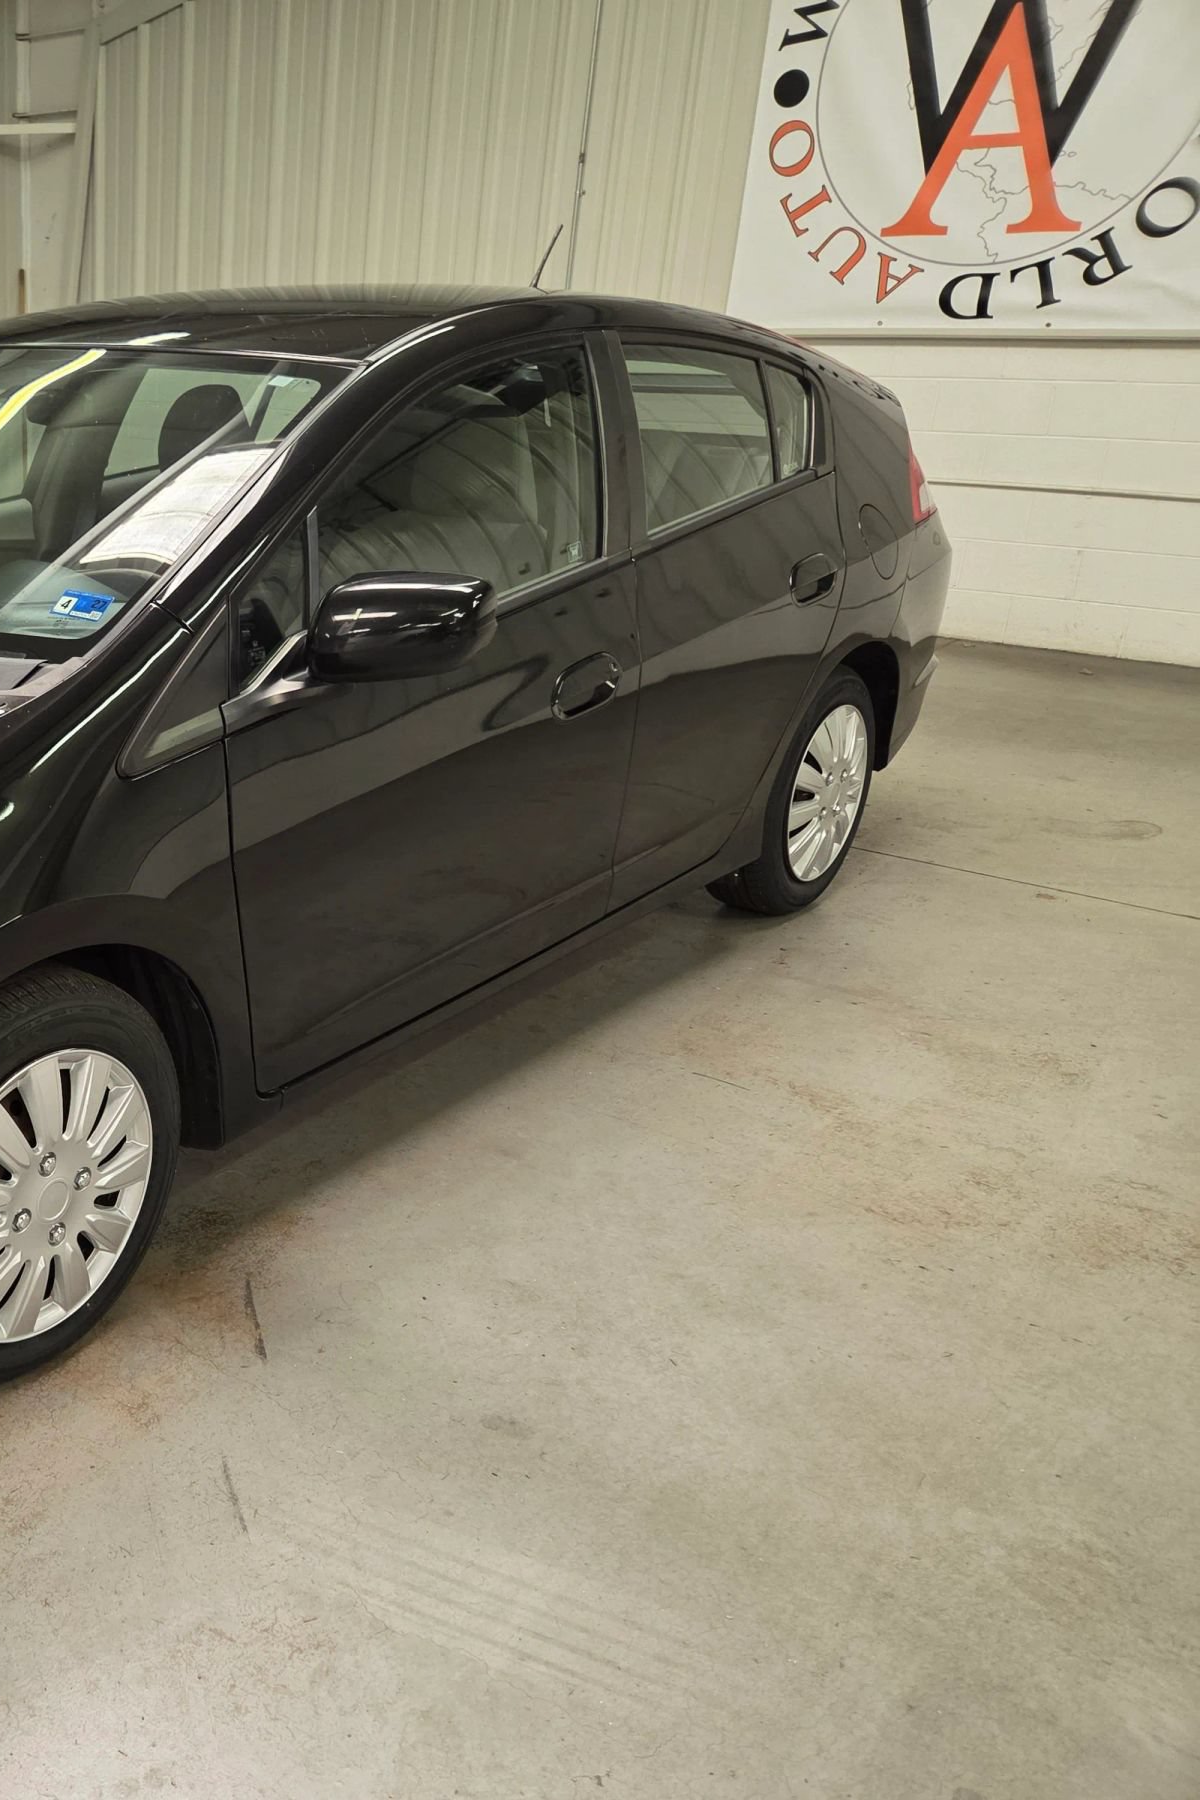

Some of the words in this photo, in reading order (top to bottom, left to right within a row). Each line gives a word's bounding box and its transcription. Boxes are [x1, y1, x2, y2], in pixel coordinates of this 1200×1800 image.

[769, 119, 925, 304] AUTO
[938, 176, 1200, 320] ORLD
[61, 599, 73, 610] 4
